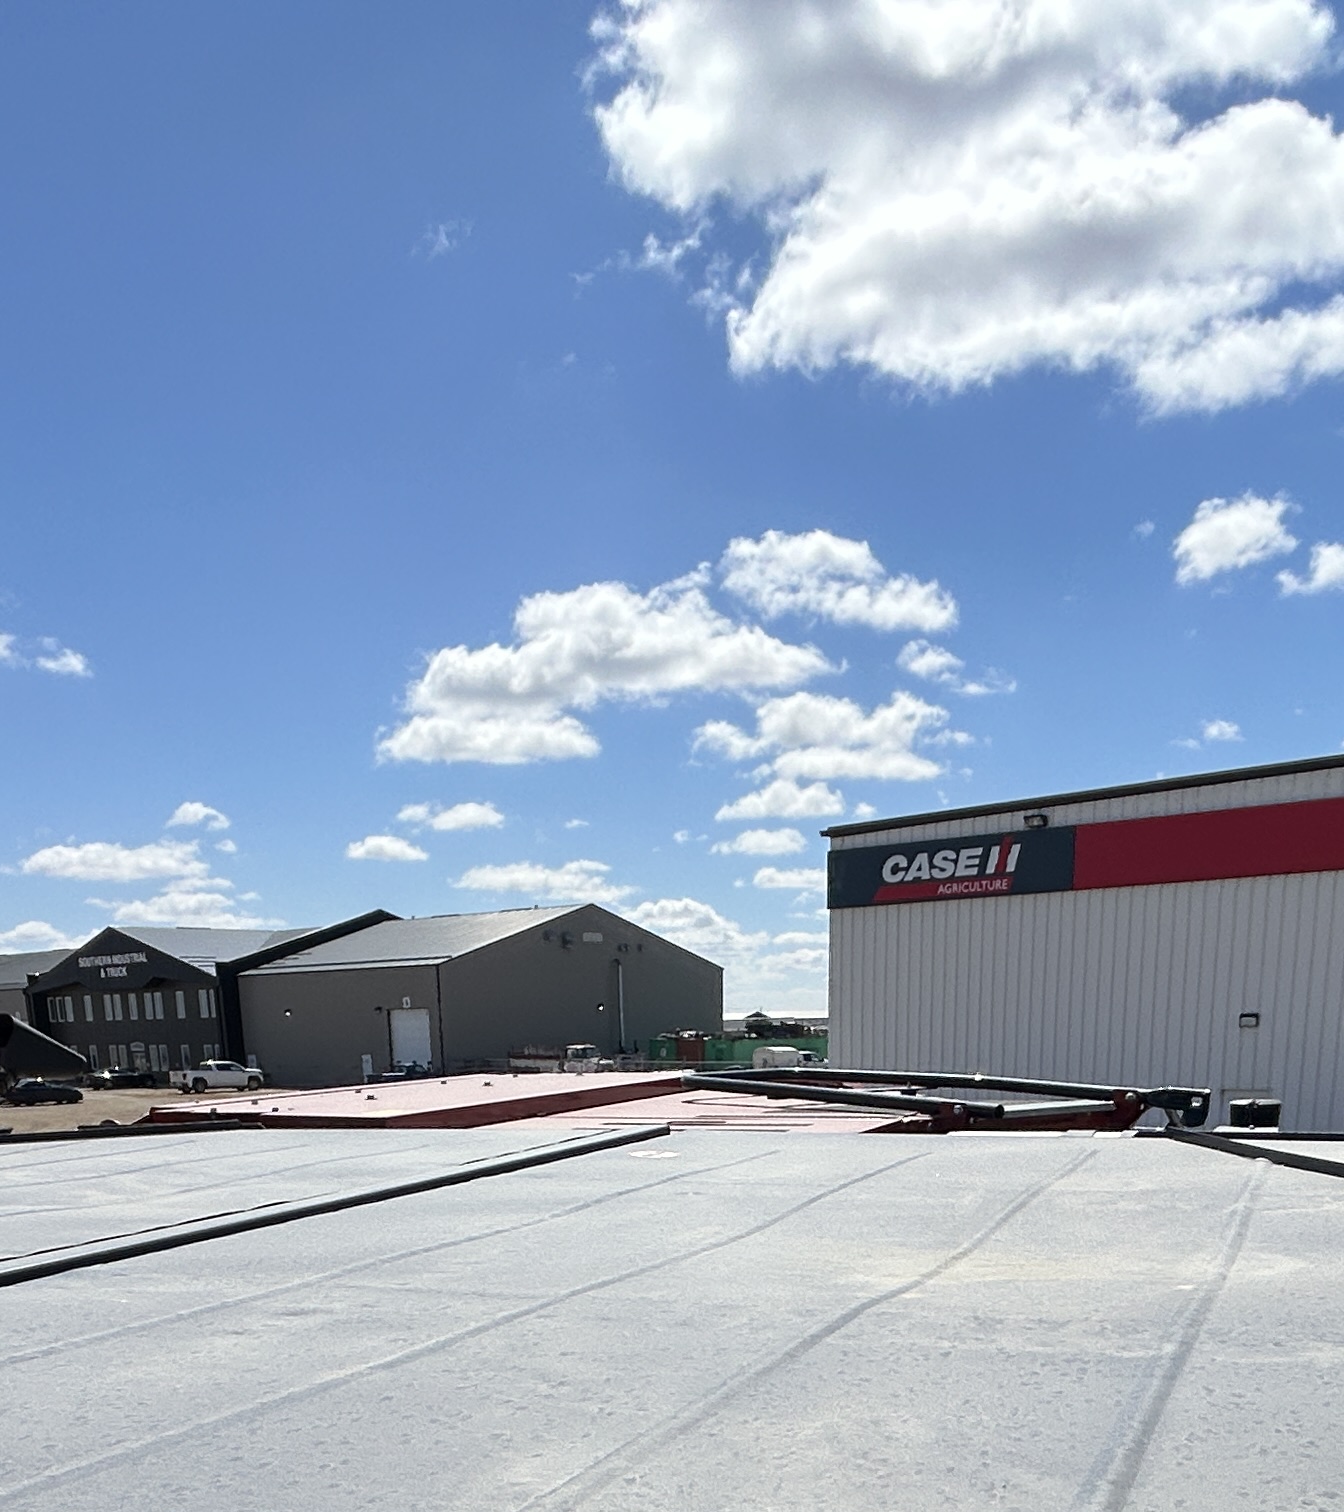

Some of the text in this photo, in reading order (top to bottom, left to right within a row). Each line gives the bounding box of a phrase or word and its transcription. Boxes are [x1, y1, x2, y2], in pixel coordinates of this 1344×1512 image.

[882, 847, 984, 883] CASE
[937, 879, 1008, 895] AGRICULTURE
[106, 967, 127, 977] TRUCK
